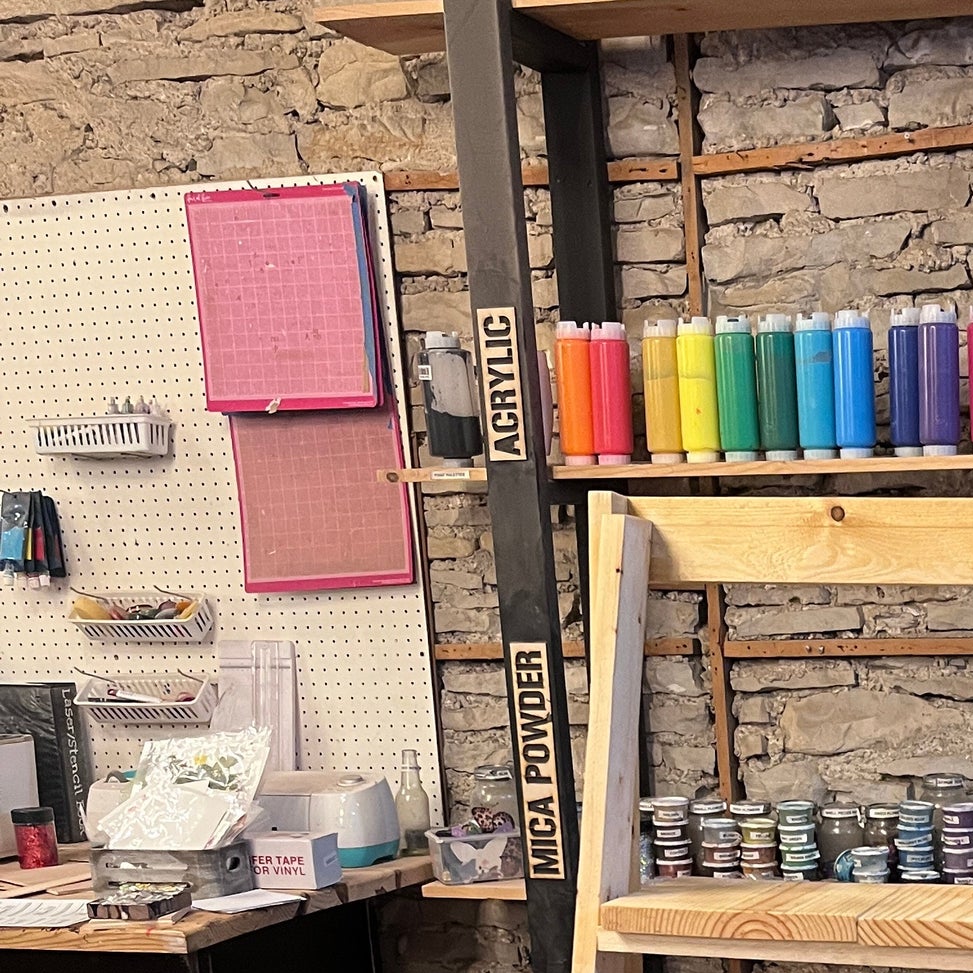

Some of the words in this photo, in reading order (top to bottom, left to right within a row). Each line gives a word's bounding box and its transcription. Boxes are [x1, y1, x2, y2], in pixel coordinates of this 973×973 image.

[483, 315, 521, 456] ACRYLIC
[61, 688, 84, 796] Laser/Stencil
[515, 650, 554, 785] POWDER
[251, 856, 273, 865] FER
[275, 856, 305, 866] TAPE
[253, 866, 270, 875] OR
[273, 866, 306, 876] VINYL
[527, 795, 561, 875] MICA
